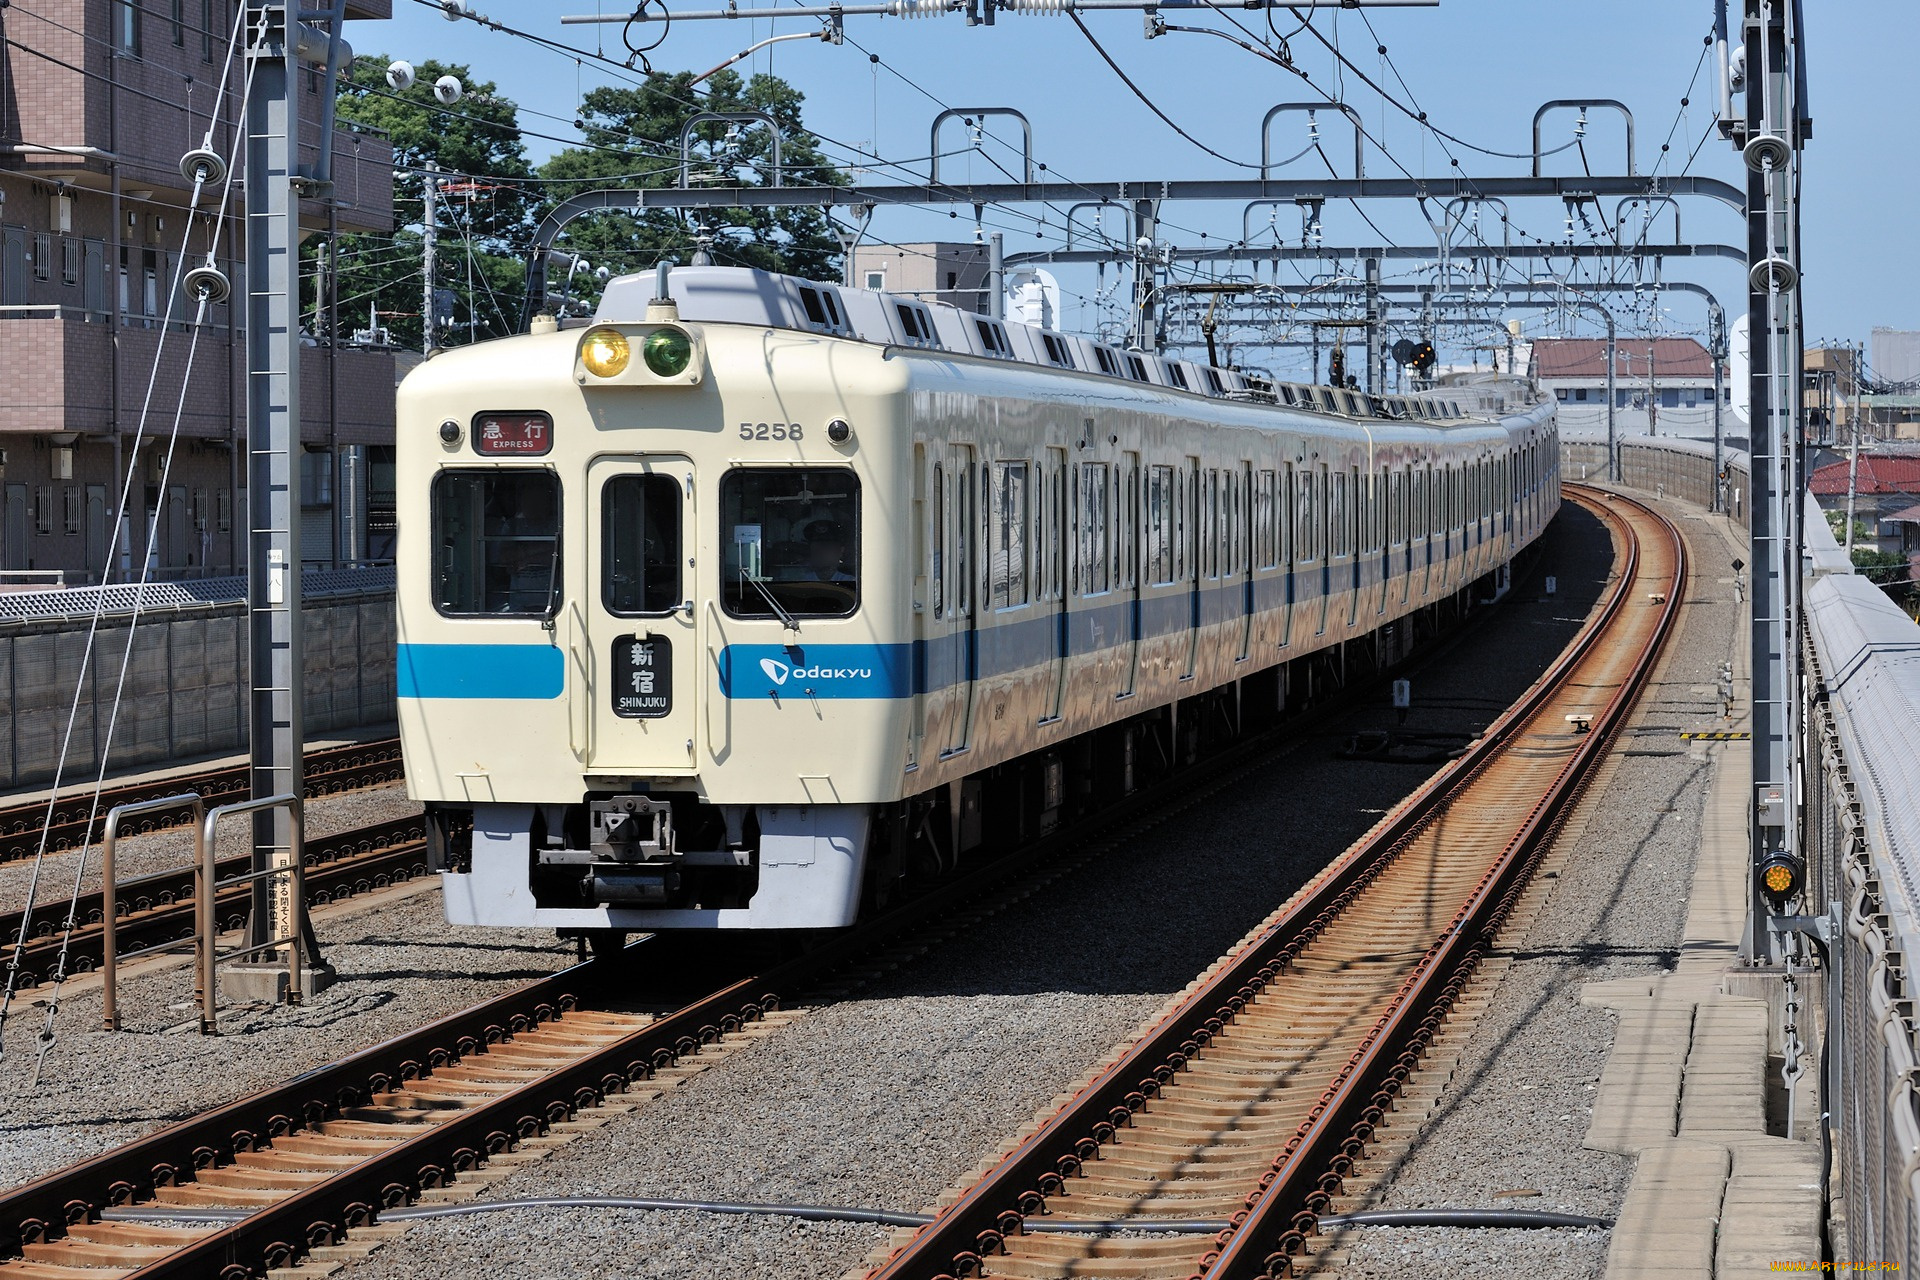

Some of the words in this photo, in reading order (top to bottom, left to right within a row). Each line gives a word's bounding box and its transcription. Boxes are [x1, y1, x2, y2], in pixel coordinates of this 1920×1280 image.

[483, 420, 544, 439] 急行
[739, 423, 804, 441] 5258
[493, 440, 534, 448] EXPRESS
[631, 642, 656, 694] 新宿
[793, 665, 871, 679] odakyu
[619, 697, 667, 708] SHINJUKU
